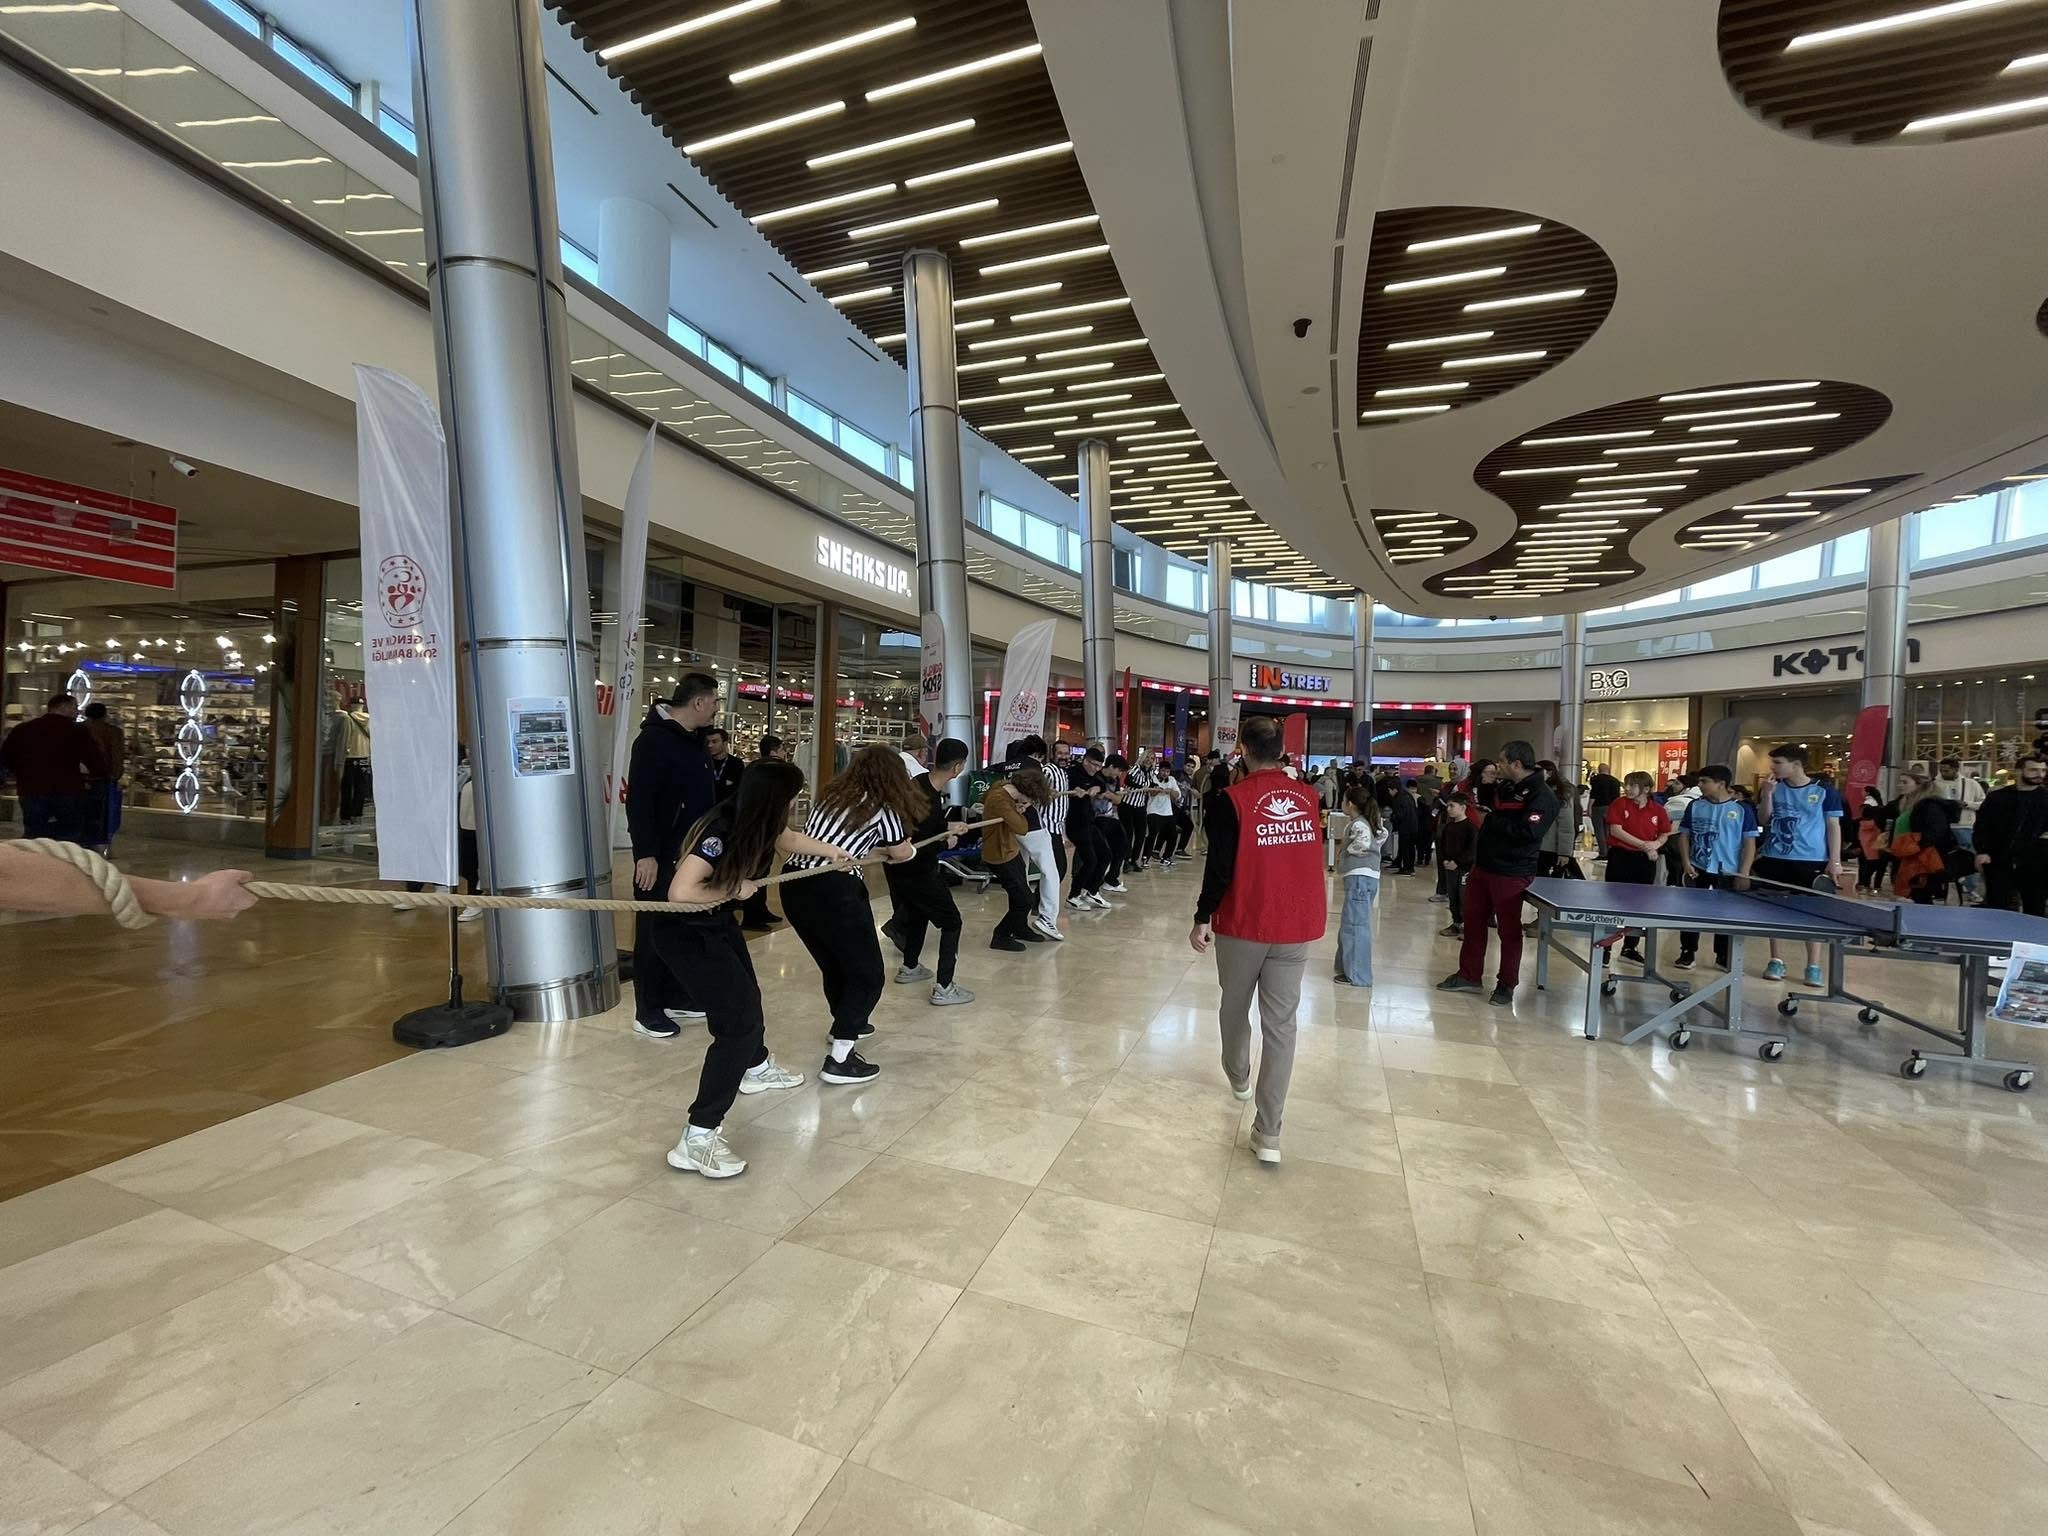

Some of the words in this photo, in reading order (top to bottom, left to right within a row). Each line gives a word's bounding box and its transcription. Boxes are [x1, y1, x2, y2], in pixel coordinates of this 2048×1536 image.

[817, 535, 885, 588] SNEAKS
[1666, 747, 1688, 758] sale
[1256, 820, 1313, 836] GENÇLİK
[1585, 913, 1624, 925] Butterfly
